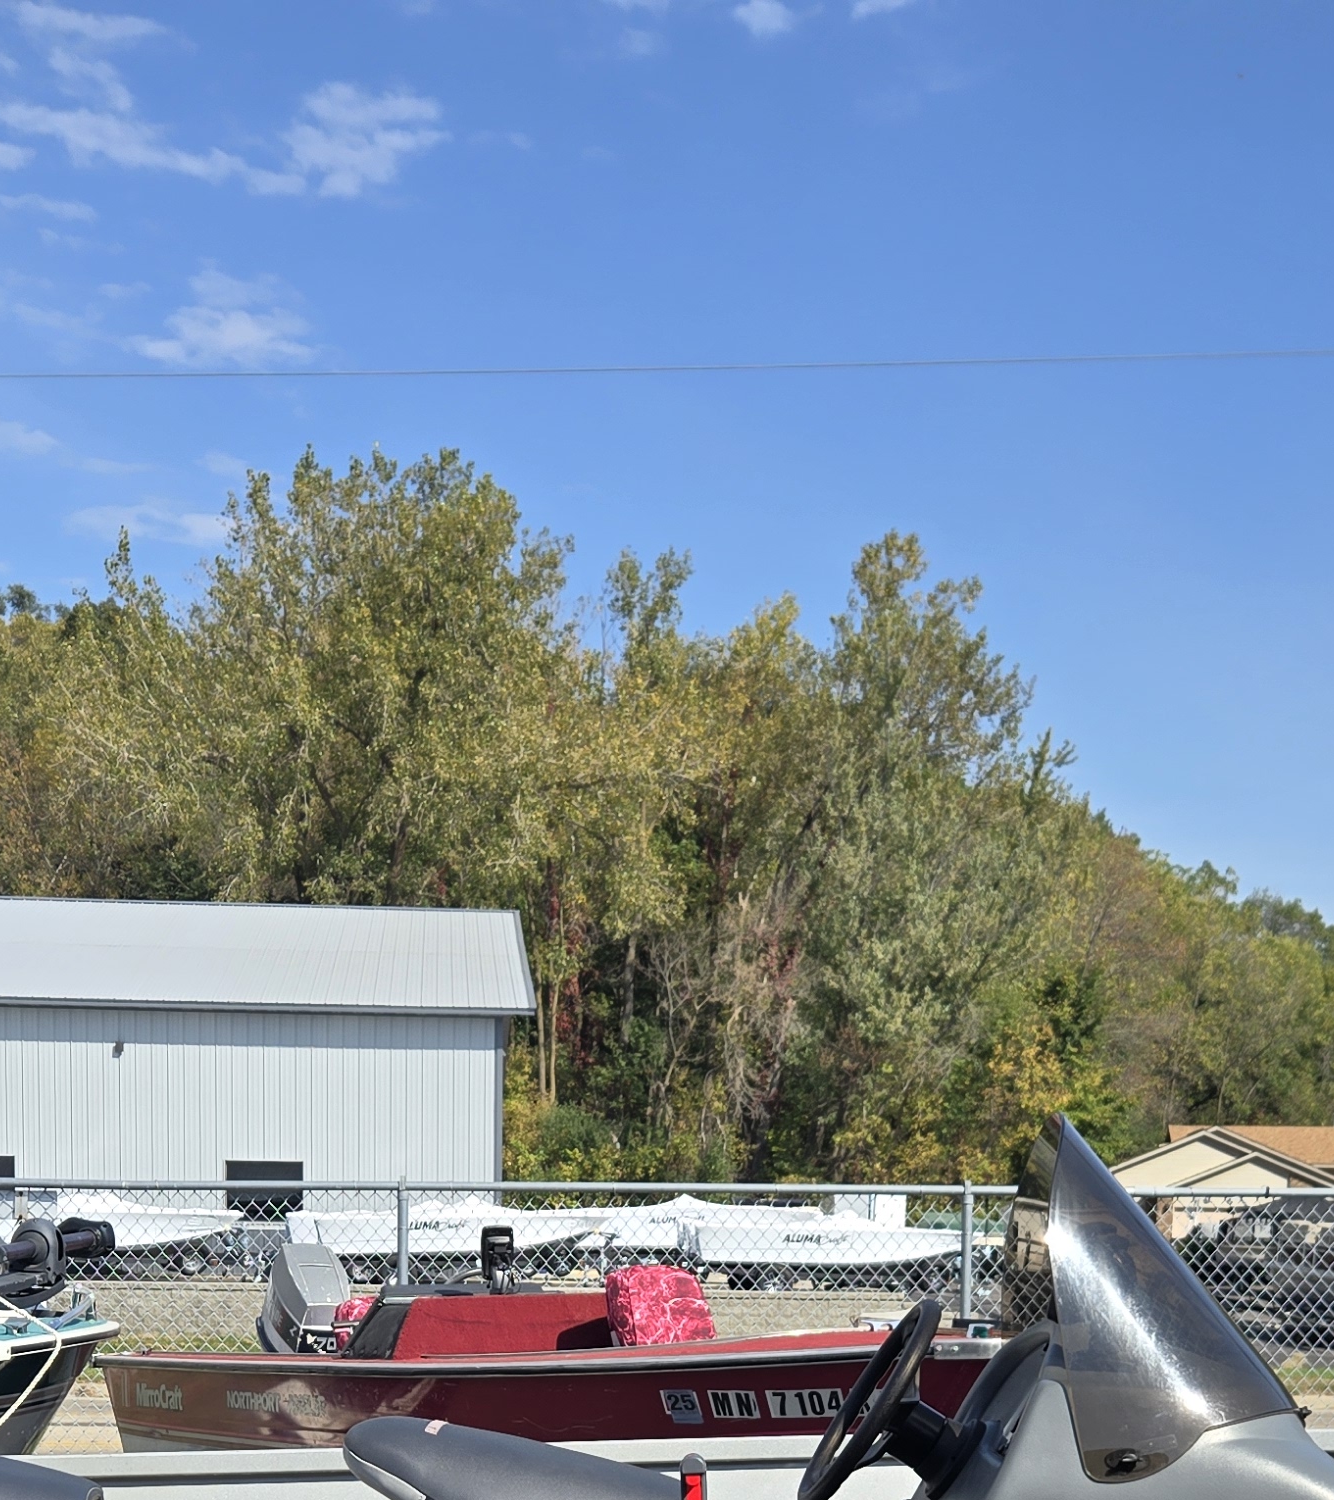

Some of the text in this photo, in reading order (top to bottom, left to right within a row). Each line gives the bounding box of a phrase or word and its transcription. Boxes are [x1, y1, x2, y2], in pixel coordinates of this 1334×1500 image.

[667, 1394, 695, 1411] 25
[711, 1392, 754, 1416] MN
[772, 1392, 841, 1416] 7104
